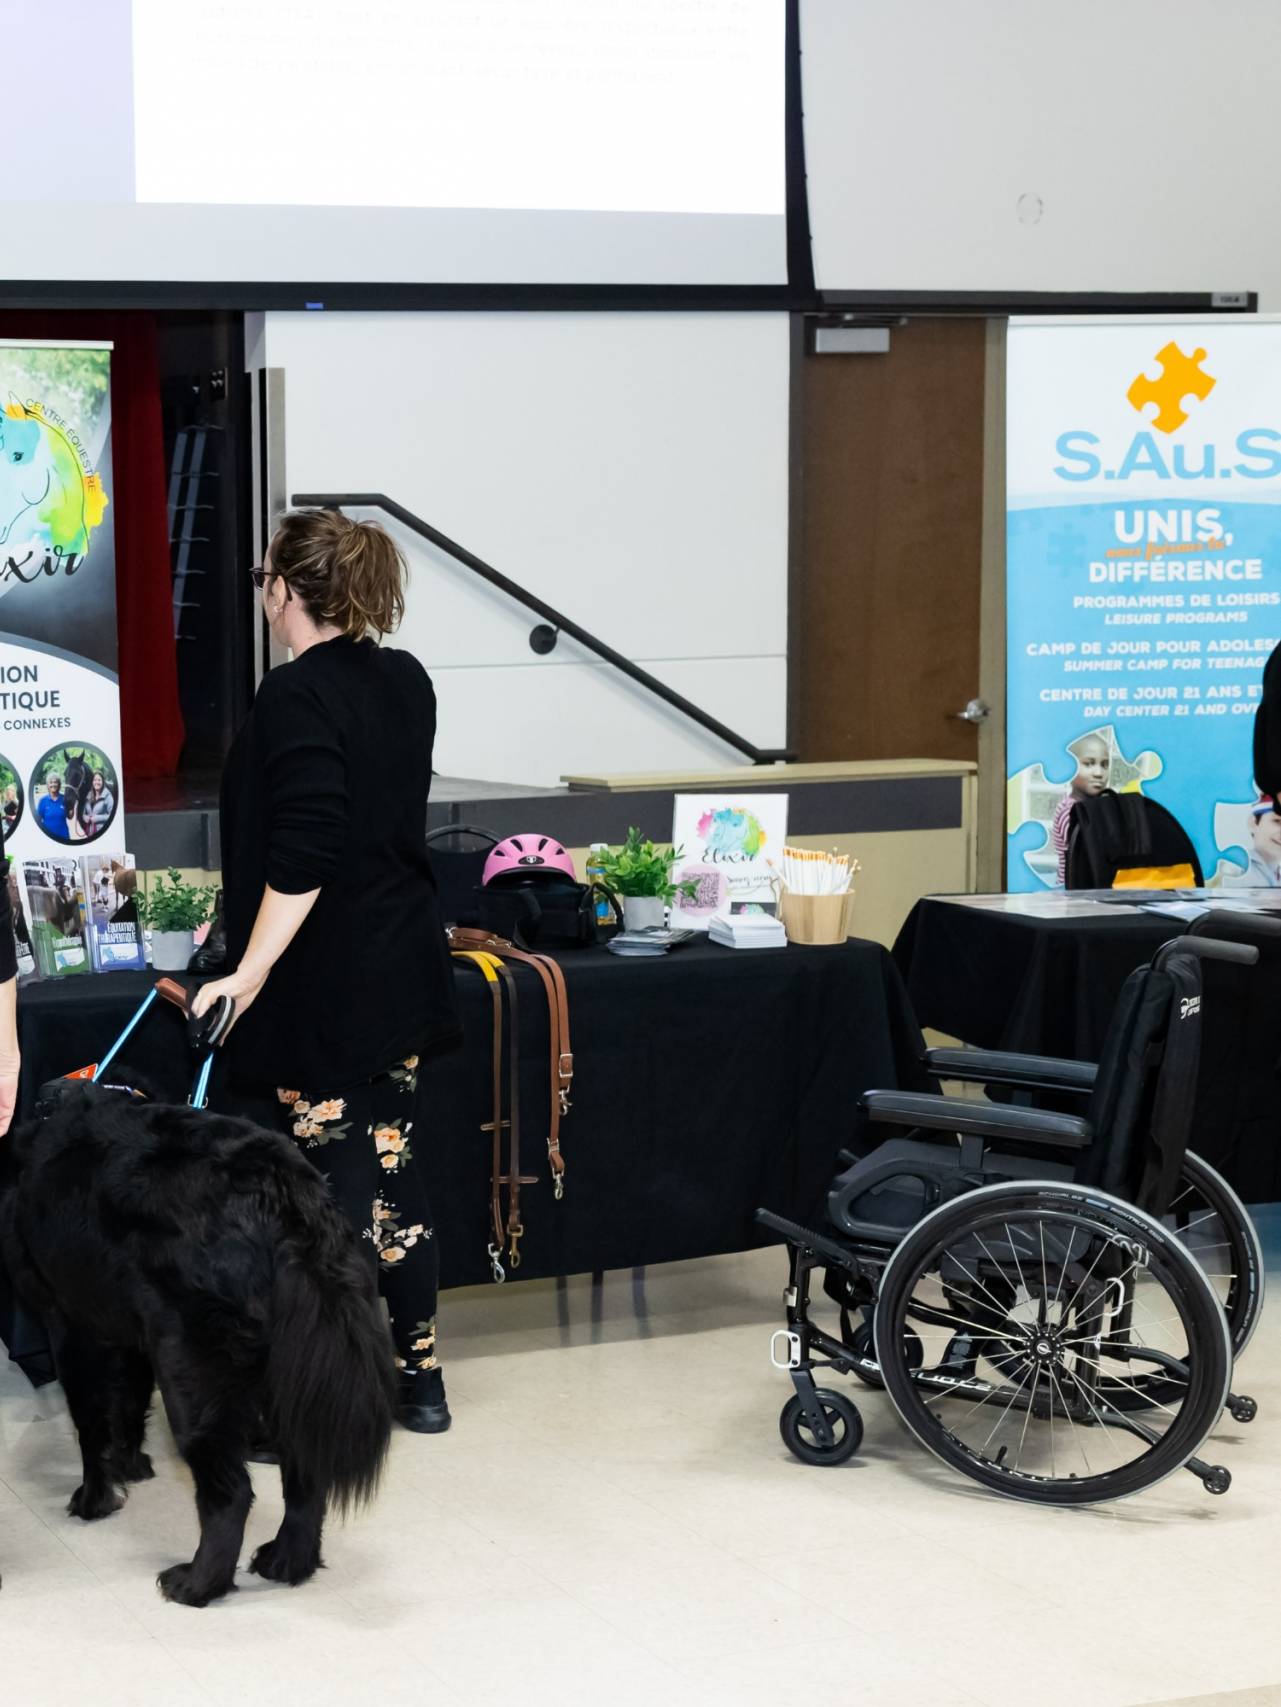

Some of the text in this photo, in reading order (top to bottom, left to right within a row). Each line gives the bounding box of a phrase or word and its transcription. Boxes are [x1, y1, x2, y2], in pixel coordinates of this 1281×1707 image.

[25, 398, 66, 431] CENTRE
[1114, 508, 1233, 545] UNIS,
[1089, 555, 1262, 583] DIFFÉRENCE
[1073, 592, 1281, 608] PROGRAMMES DE LOISIRS
[1104, 611, 1248, 625] LEISURE PROGRAMS
[1026, 642, 1075, 656] CAMP
[1081, 642, 1101, 655] DE
[1107, 641, 1150, 655] JOUR
[1156, 640, 1201, 653] POUR
[1064, 656, 1269, 672] SUMMER CAMP FOR TEENAG
[1040, 688, 1102, 702] CENTRE
[1107, 687, 1128, 700] DE
[1133, 686, 1177, 700] JOUR
[1183, 686, 1200, 699] 21
[1206, 685, 1242, 698] ANS
[1084, 706, 1111, 718] DAY
[1116, 705, 1169, 717] CENTER
[1174, 704, 1189, 716] 21
[1194, 703, 1226, 715] AND
[3, 716, 71, 732] CONNEXES
